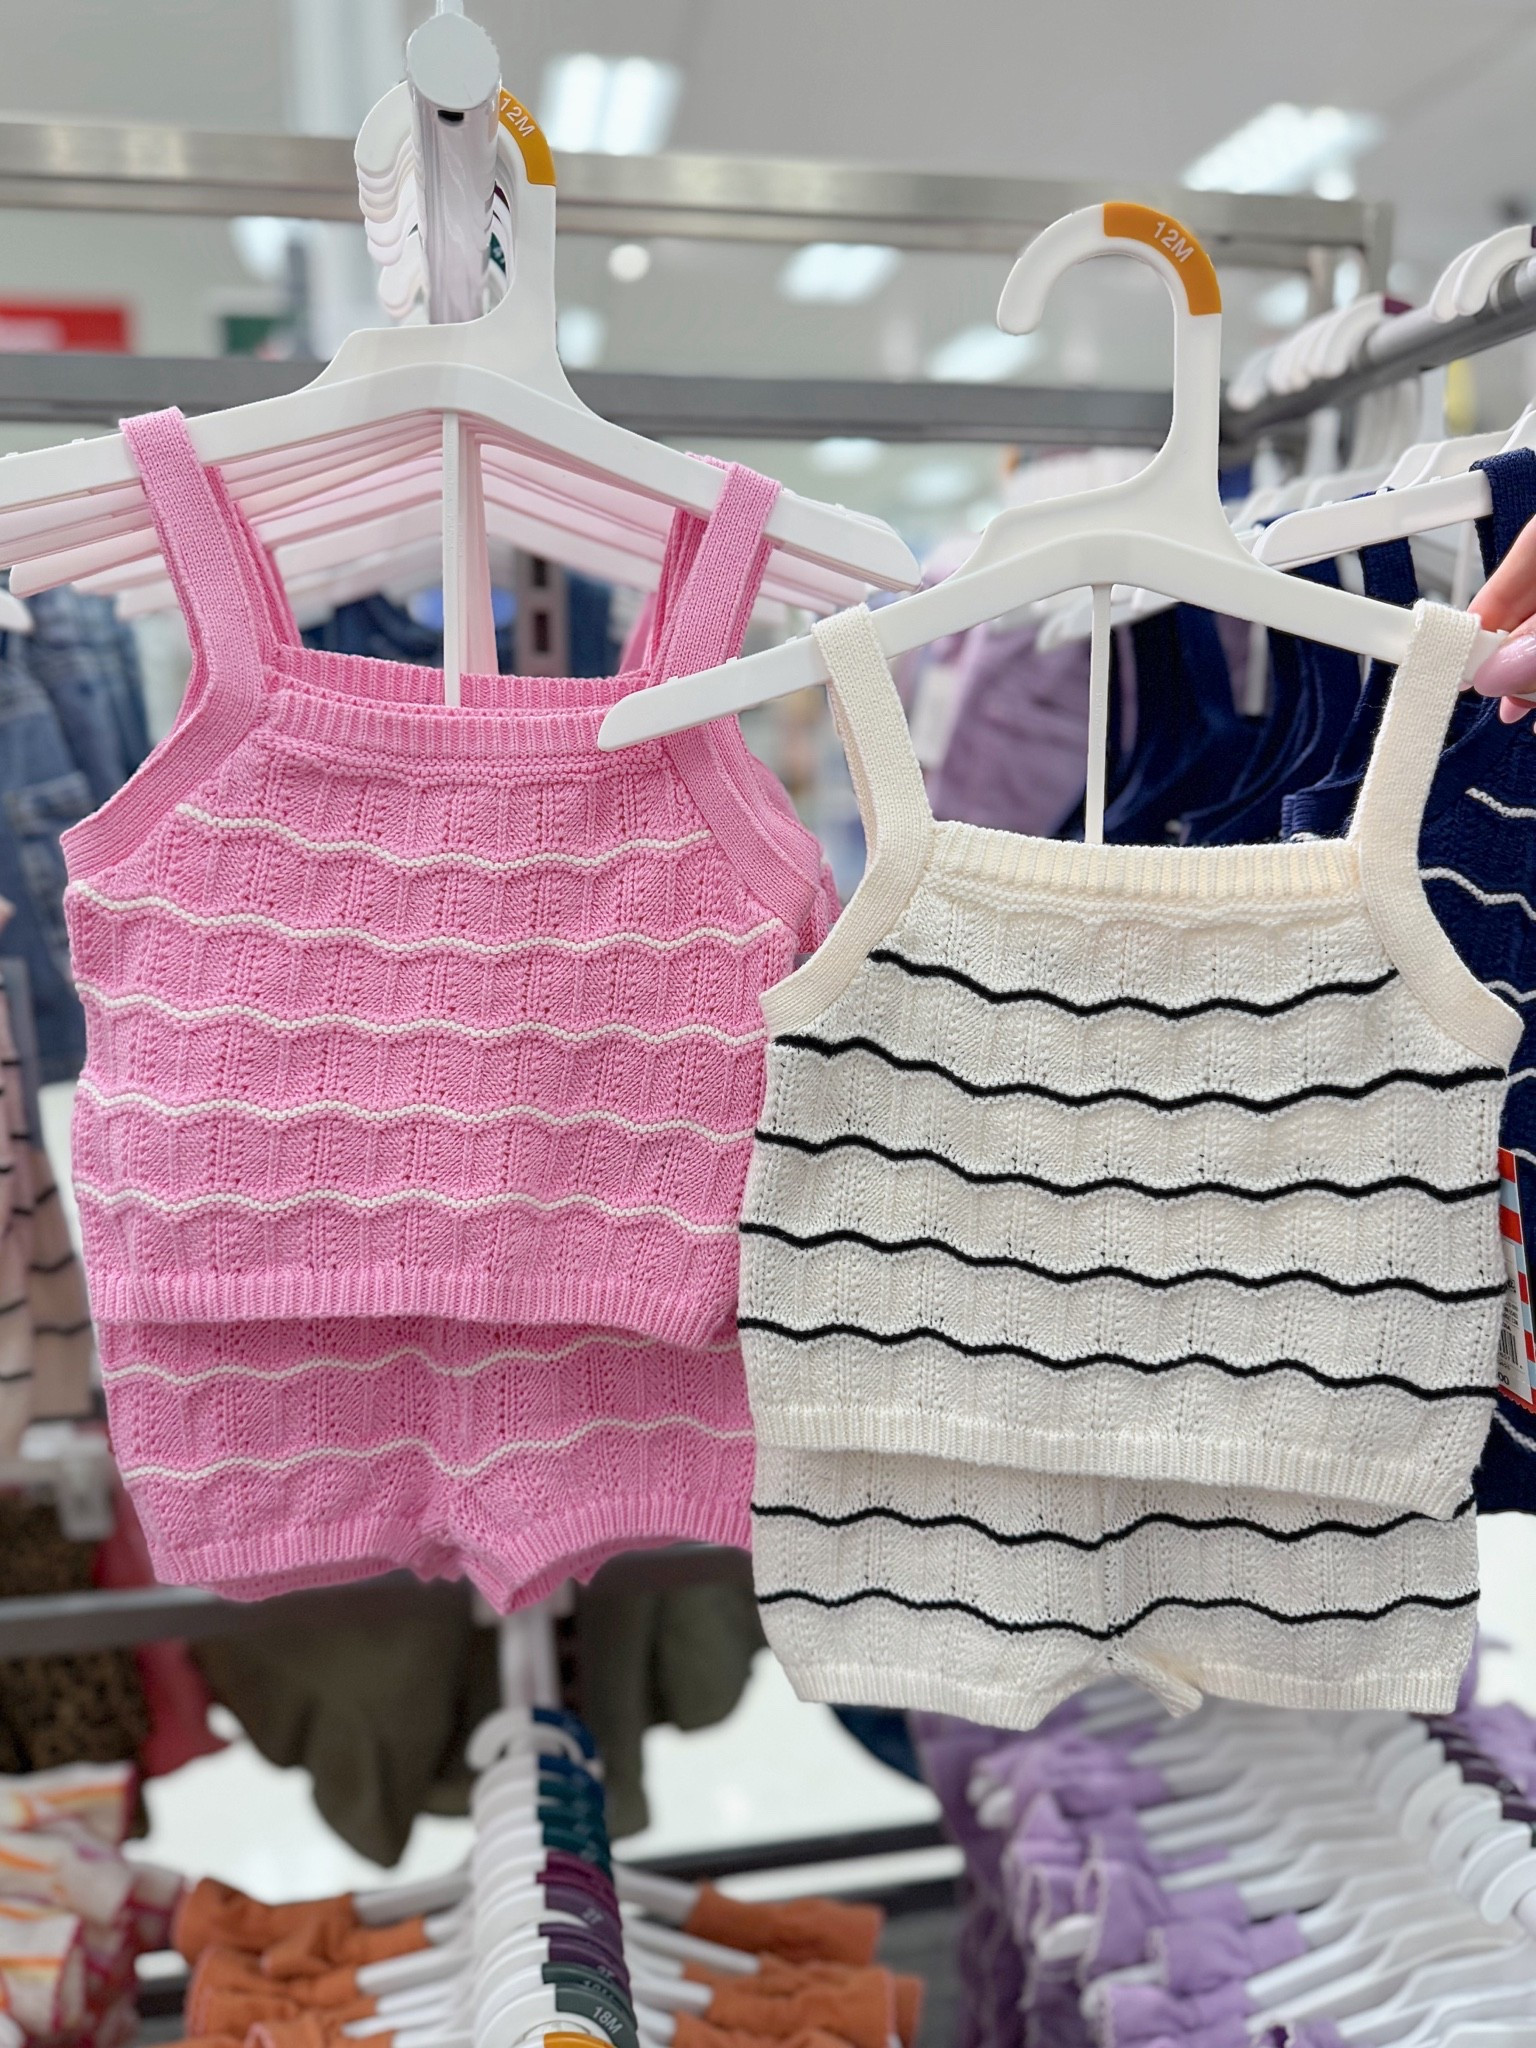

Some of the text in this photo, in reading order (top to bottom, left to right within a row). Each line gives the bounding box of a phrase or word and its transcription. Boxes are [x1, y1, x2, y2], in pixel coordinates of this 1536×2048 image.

[501, 97, 535, 137] 12M
[1154, 222, 1194, 263] 12M
[593, 2006, 623, 2034] 18M
